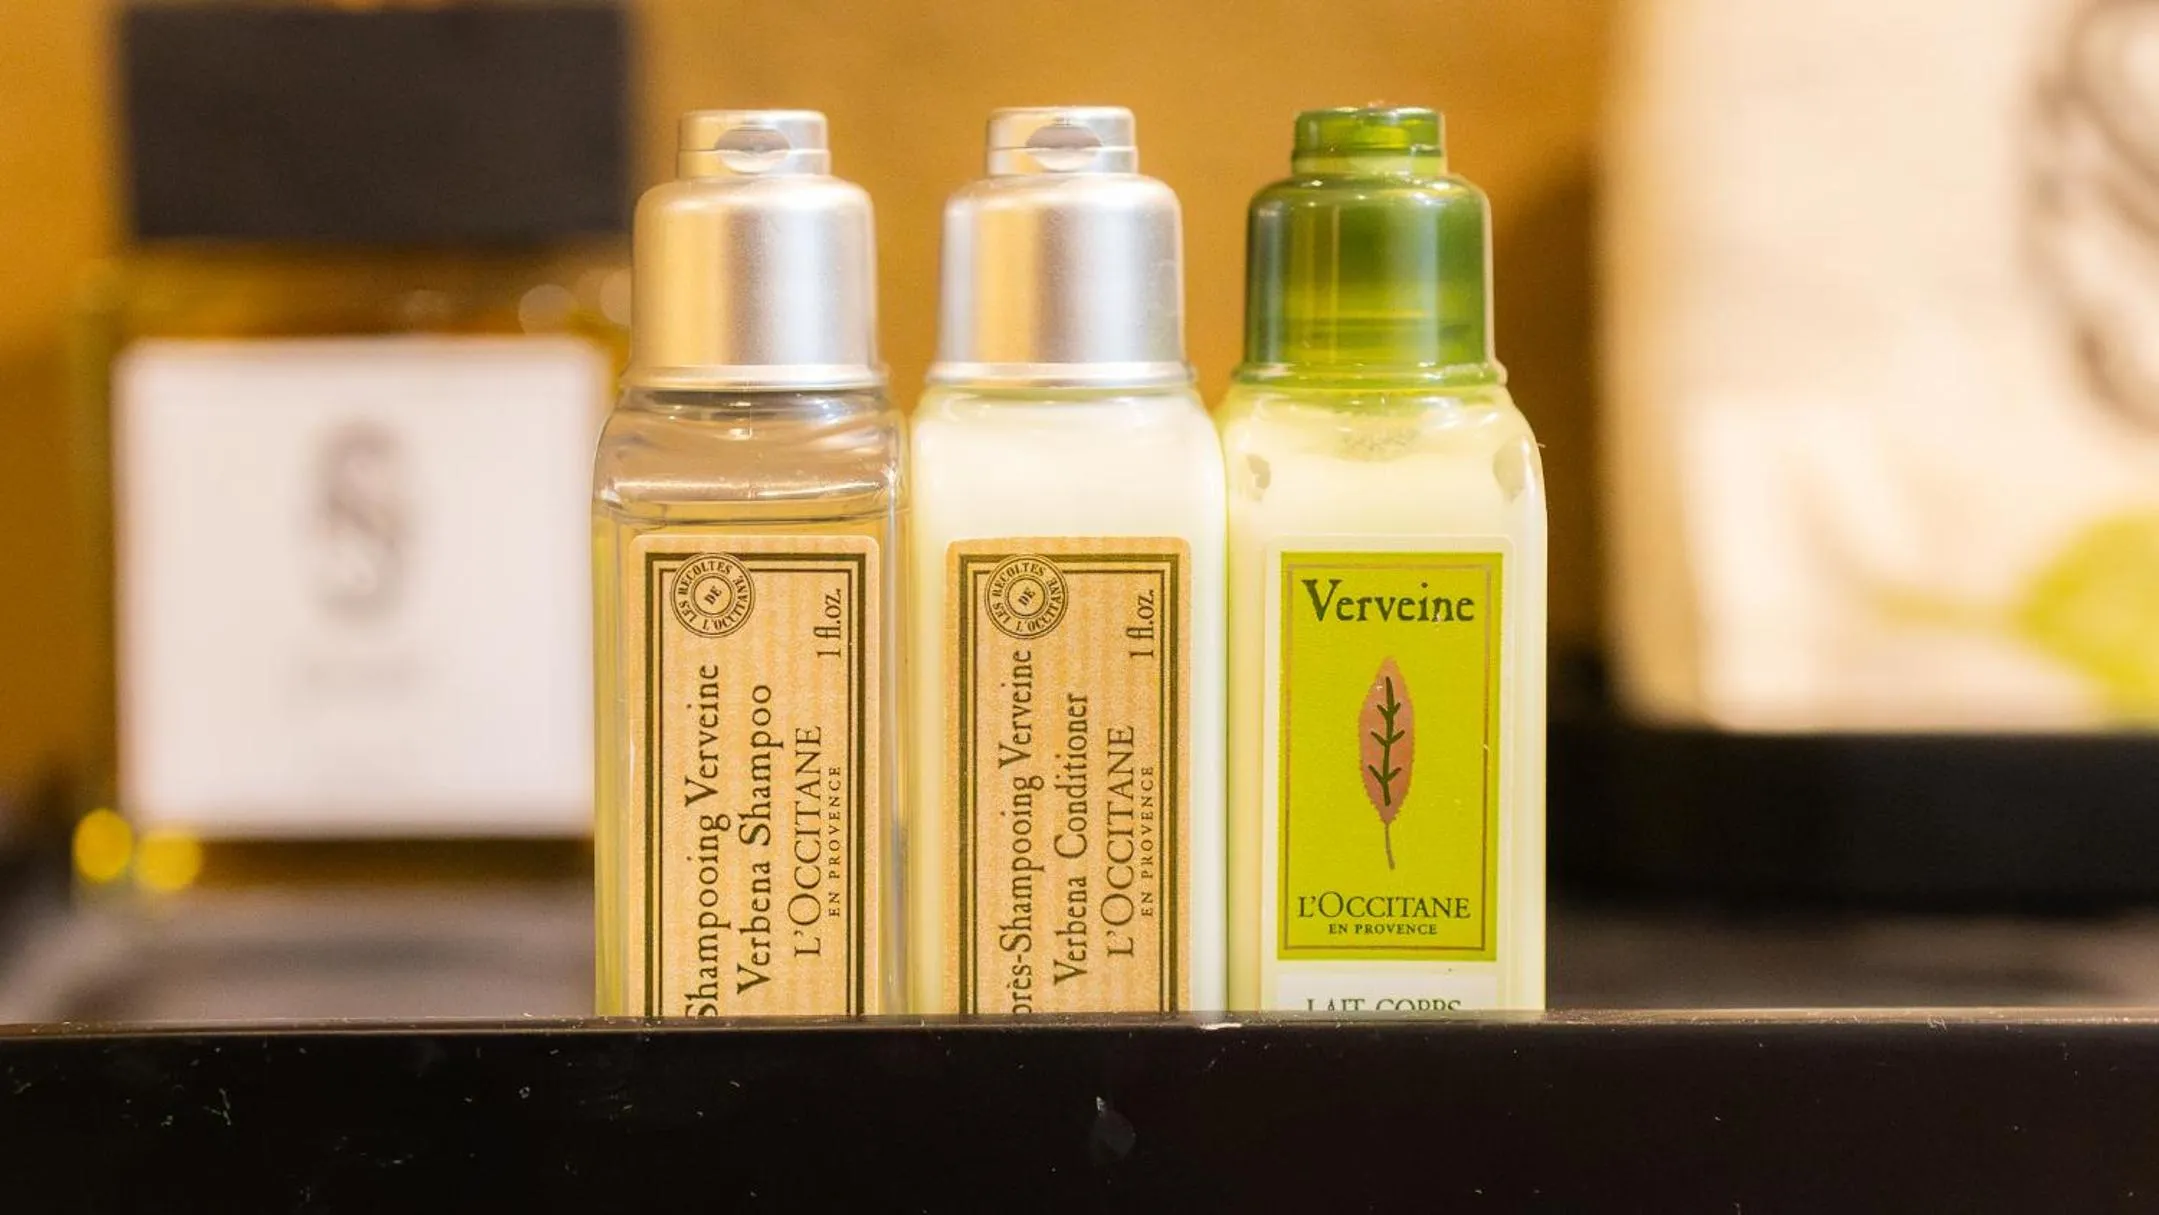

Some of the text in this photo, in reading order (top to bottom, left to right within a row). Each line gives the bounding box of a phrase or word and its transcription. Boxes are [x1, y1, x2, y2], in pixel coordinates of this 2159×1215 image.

[679, 600, 698, 623] LES
[704, 585, 722, 605] DE
[993, 603, 1012, 624] LES
[1018, 586, 1036, 607] DE
[1302, 579, 1474, 622] Verveine
[816, 648, 841, 659] 1
[1129, 650, 1154, 659] 1
[998, 650, 1032, 769] Verveine
[685, 665, 731, 1017] Shampooing Verveine
[737, 685, 784, 995] Verbena Shampoo
[787, 725, 821, 957] L'OCCITANE
[829, 767, 840, 917] EN PROVENCE
[1053, 693, 1088, 986] Verbena Conditioner
[1100, 725, 1134, 957] L'OCCITANE
[1141, 767, 1153, 917] EN PROVENCE
[1297, 891, 1471, 918] L'OCCITANE
[1329, 924, 1438, 935] EN PROVENCE
